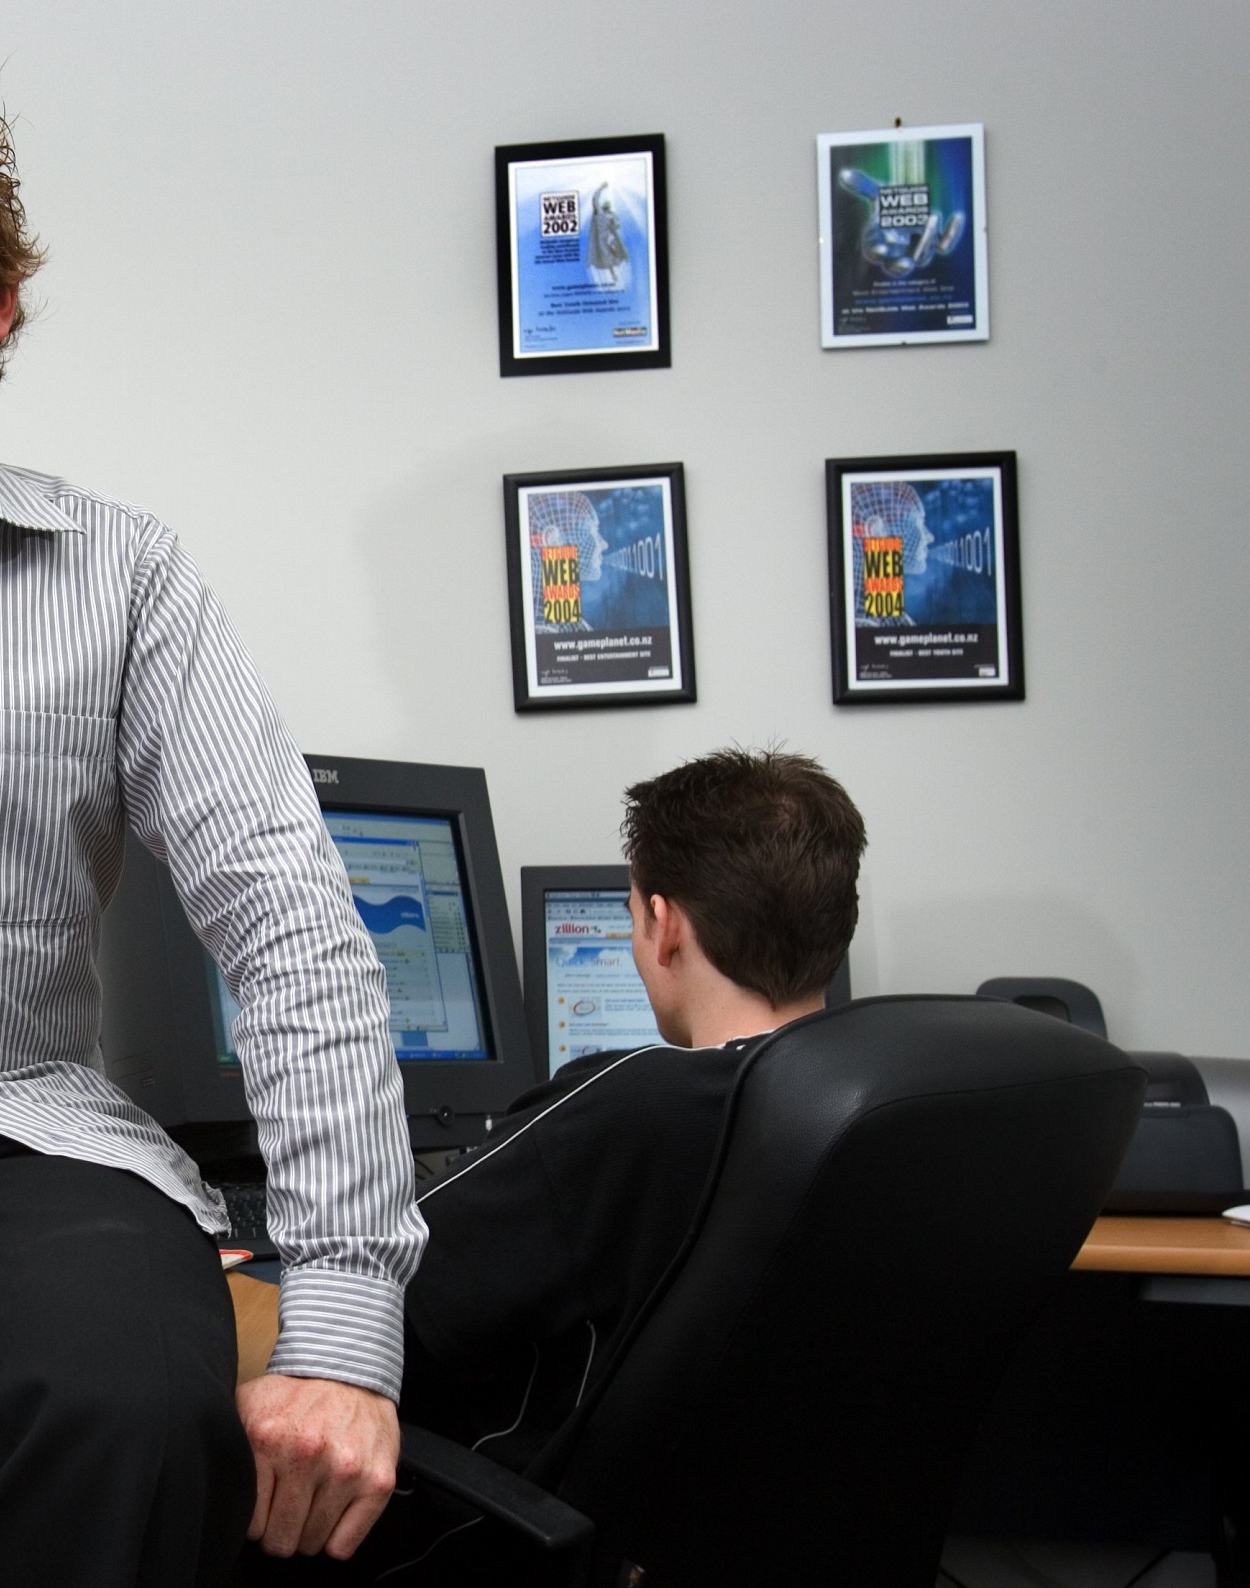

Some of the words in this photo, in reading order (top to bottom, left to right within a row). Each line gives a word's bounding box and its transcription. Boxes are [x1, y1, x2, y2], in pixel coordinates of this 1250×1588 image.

[543, 201, 576, 214] WEB
[881, 193, 928, 207] WEB
[543, 220, 578, 234] 2002
[542, 559, 579, 586] WEB
[865, 552, 904, 578] WEB
[544, 600, 581, 623] 2004
[865, 592, 904, 617] 2004
[554, 635, 653, 651] www.gameplanet.co.nz
[874, 632, 979, 647] www.gameplanet.co.nz
[313, 769, 339, 784] IBM
[555, 923, 590, 934] zillion
